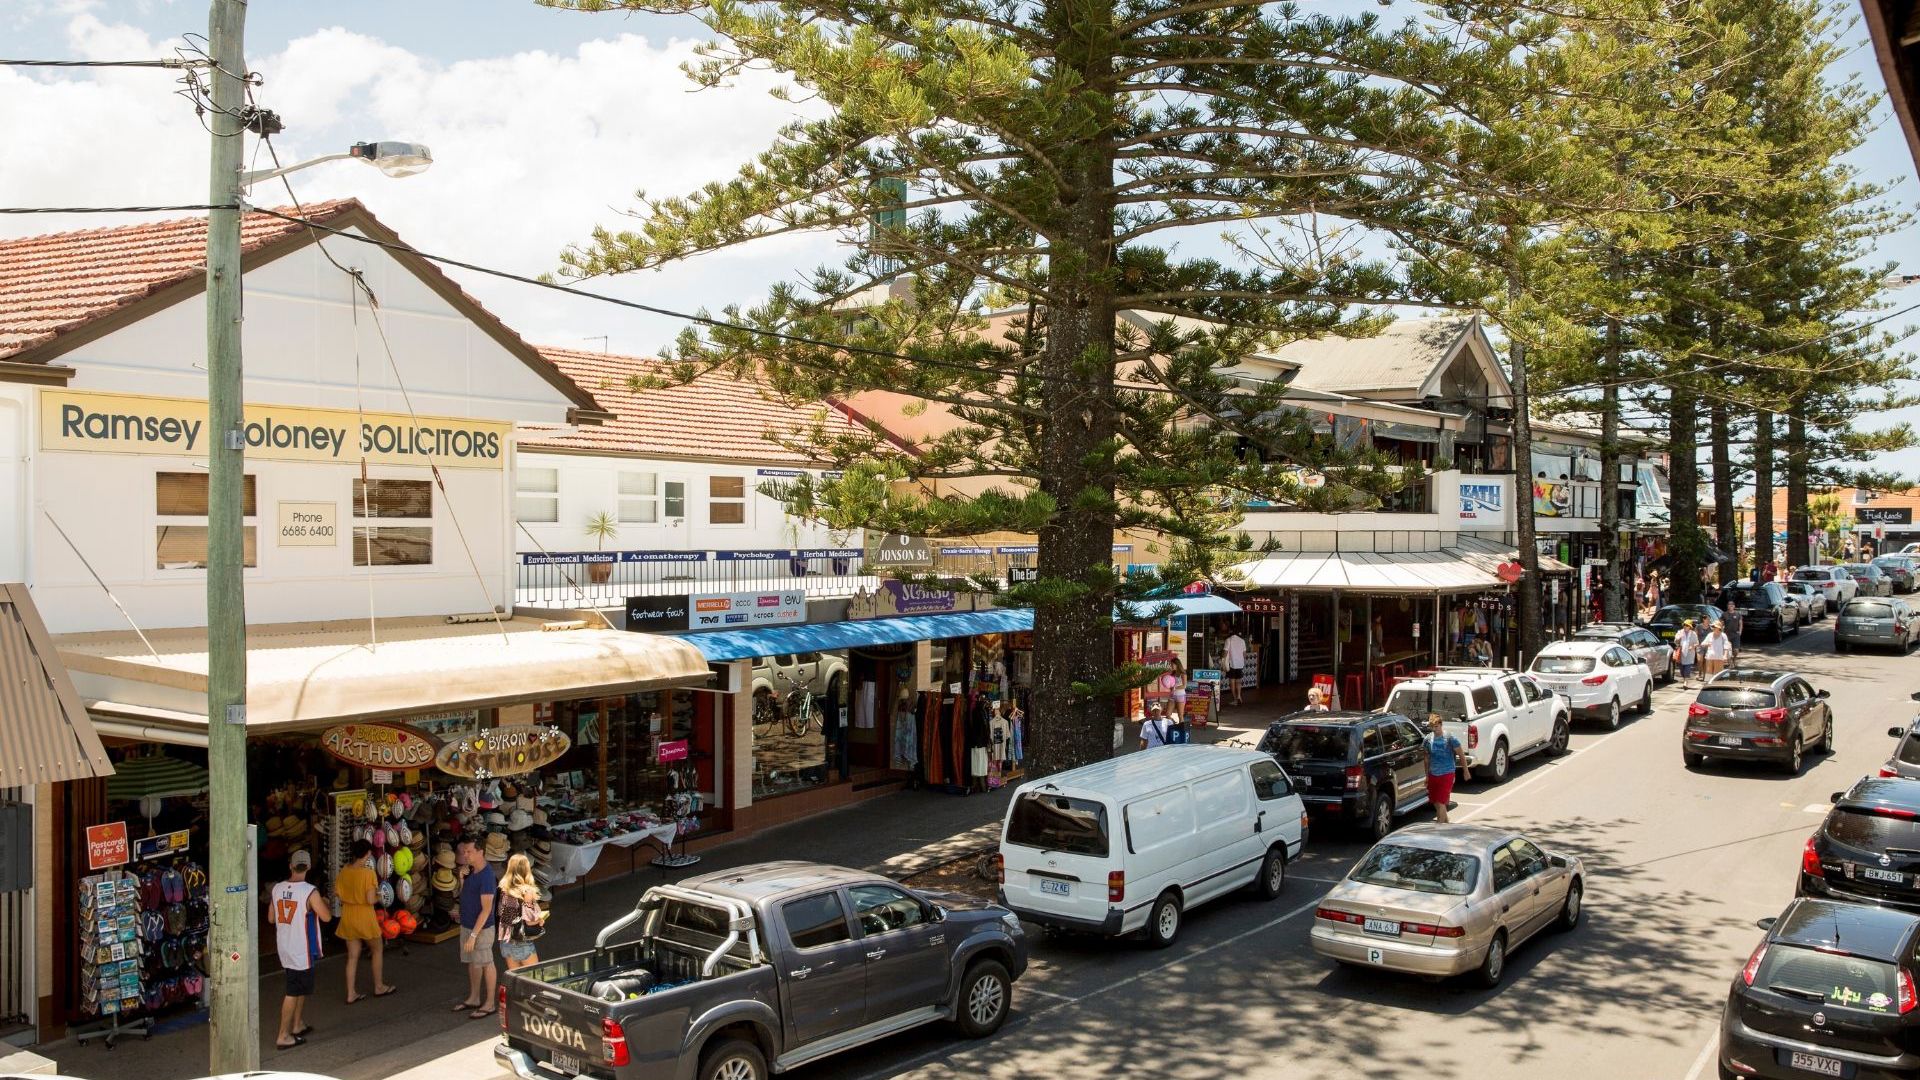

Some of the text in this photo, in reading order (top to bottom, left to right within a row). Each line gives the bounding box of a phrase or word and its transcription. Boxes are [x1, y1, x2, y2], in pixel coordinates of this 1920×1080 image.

[62, 404, 499, 459] Ramsey oloney SOLICITORS
[293, 512, 322, 523] Phone
[282, 526, 333, 537] 6685 6400
[527, 554, 614, 564] Environmental Medicine
[629, 552, 700, 560] Aromatherapy
[803, 550, 827, 558] Herbal
[879, 549, 915, 561] JONSON
[1012, 569, 1025, 582] The
[1465, 600, 1512, 611] kebabs
[631, 607, 685, 620] footwear focus
[356, 725, 398, 743] BYRON
[1173, 731, 1179, 741] P
[488, 733, 527, 751] BYRON
[327, 733, 431, 764] ARTHOUSE
[90, 837, 126, 850] Postcards
[93, 845, 125, 857] 10 for $5
[277, 899, 298, 925] 17
[1371, 950, 1380, 961] P
[520, 1011, 586, 1051] TOYOTA
